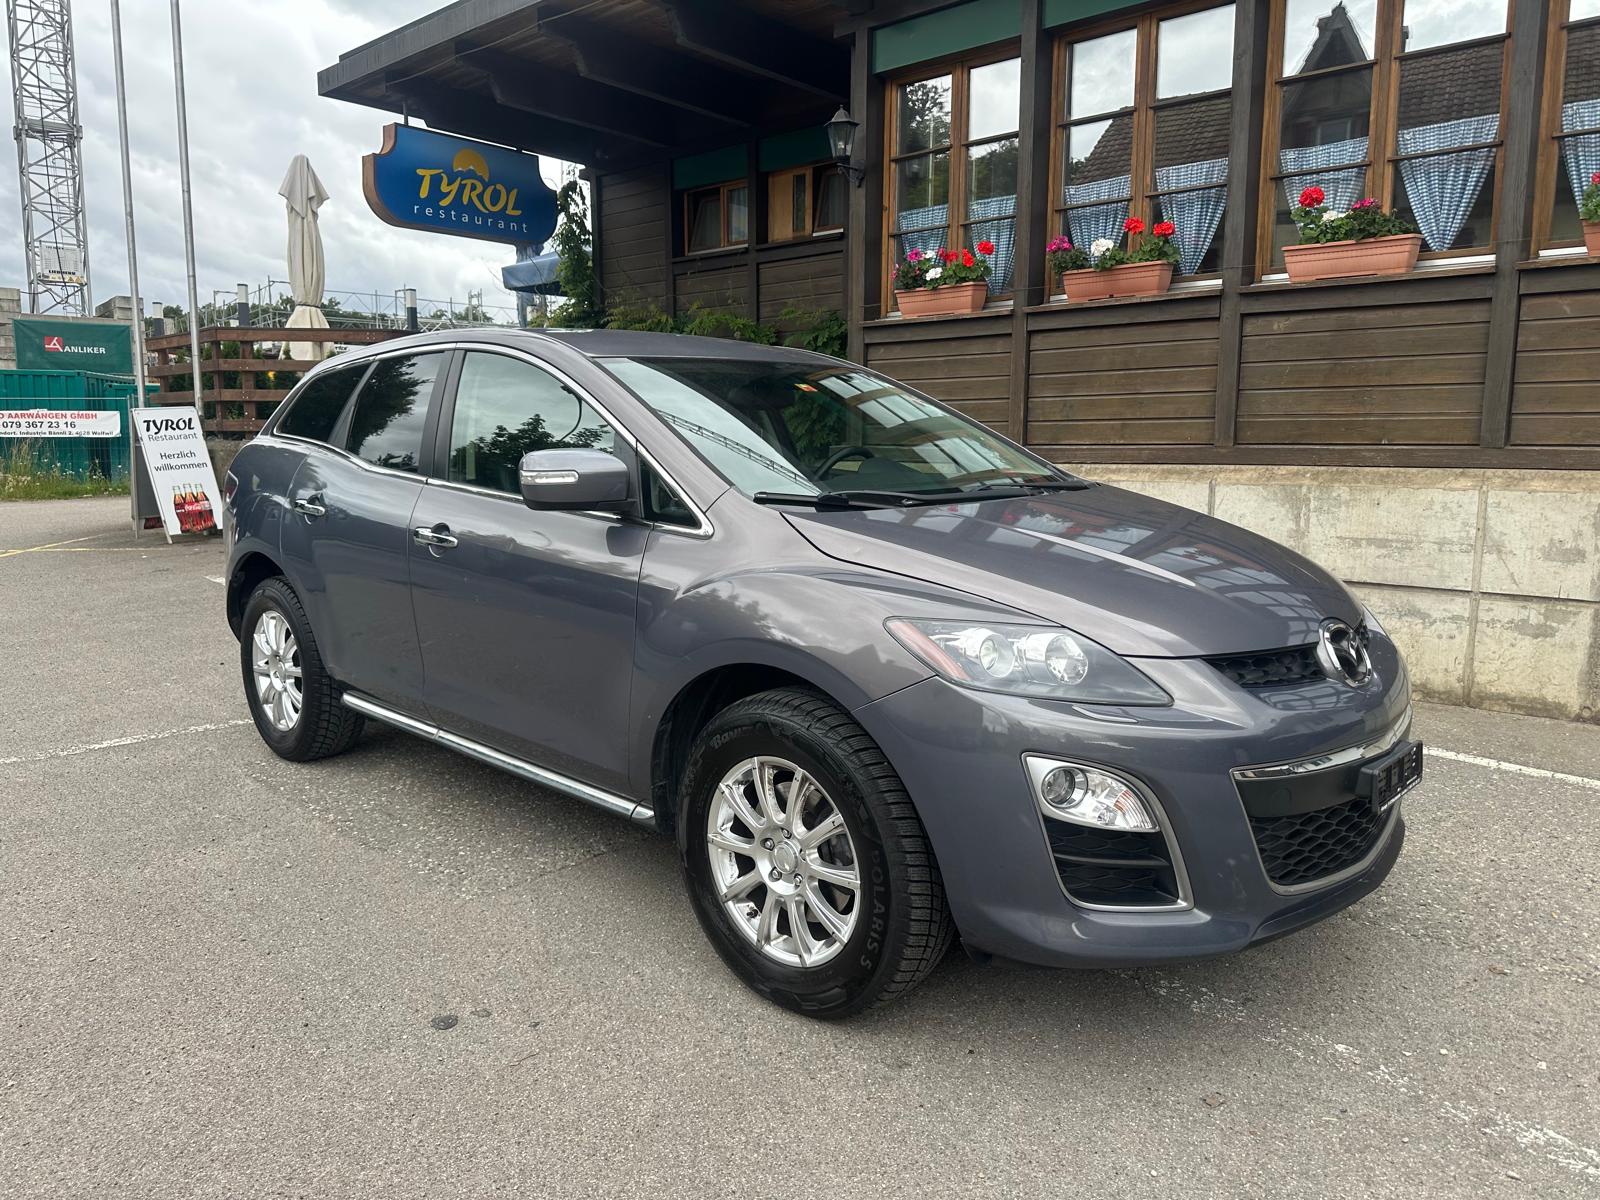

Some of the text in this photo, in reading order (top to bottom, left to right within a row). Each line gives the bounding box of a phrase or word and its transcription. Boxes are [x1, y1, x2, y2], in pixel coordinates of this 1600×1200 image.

[416, 169, 522, 215] TYROL
[414, 205, 527, 232] restaurant
[63, 346, 106, 354] ANLIKER
[143, 418, 195, 434] TYROL
[147, 432, 198, 442] Restaurant
[160, 450, 197, 460] Herzlich
[154, 461, 208, 472] willkommen
